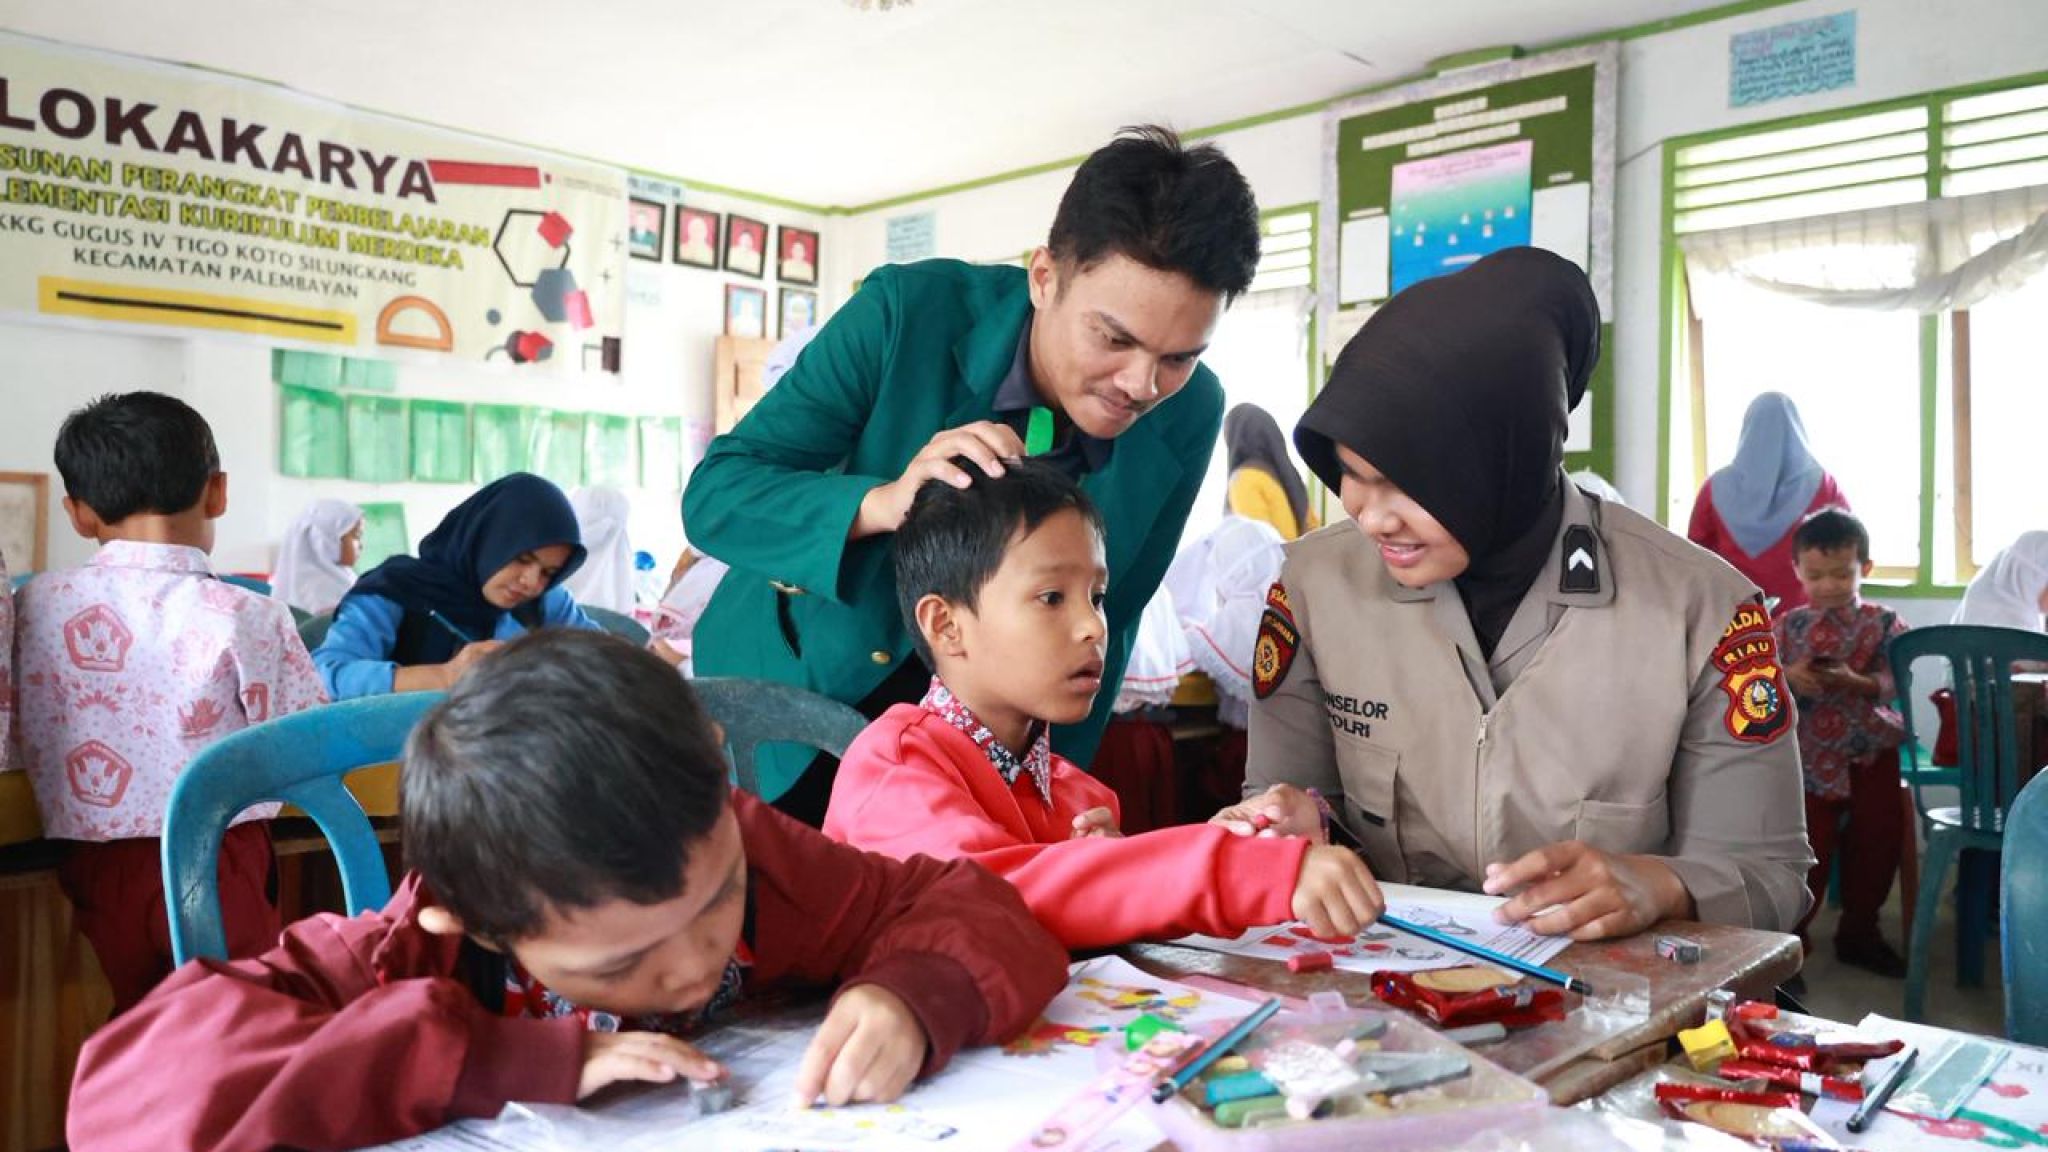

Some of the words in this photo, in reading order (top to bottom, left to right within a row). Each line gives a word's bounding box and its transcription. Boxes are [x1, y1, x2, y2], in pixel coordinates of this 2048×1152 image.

[0, 77, 436, 203] LOKAKARYA
[0, 143, 112, 184] SUNAN
[122, 163, 300, 213] PERANGKAT
[306, 195, 490, 247] PEMBELAJARAN
[53, 220, 134, 246] GUGUS
[142, 231, 166, 249] IV
[174, 236, 228, 257] TIGO
[236, 243, 293, 267] KOTO
[299, 256, 417, 287] SILUNGKANG
[179, 202, 340, 250] KURIKULUM
[347, 231, 464, 269] MERDEKA
[74, 248, 222, 279] KECAMATAN
[230, 265, 358, 298] PALEMBAYAN
[1723, 641, 1769, 665] RIAU
